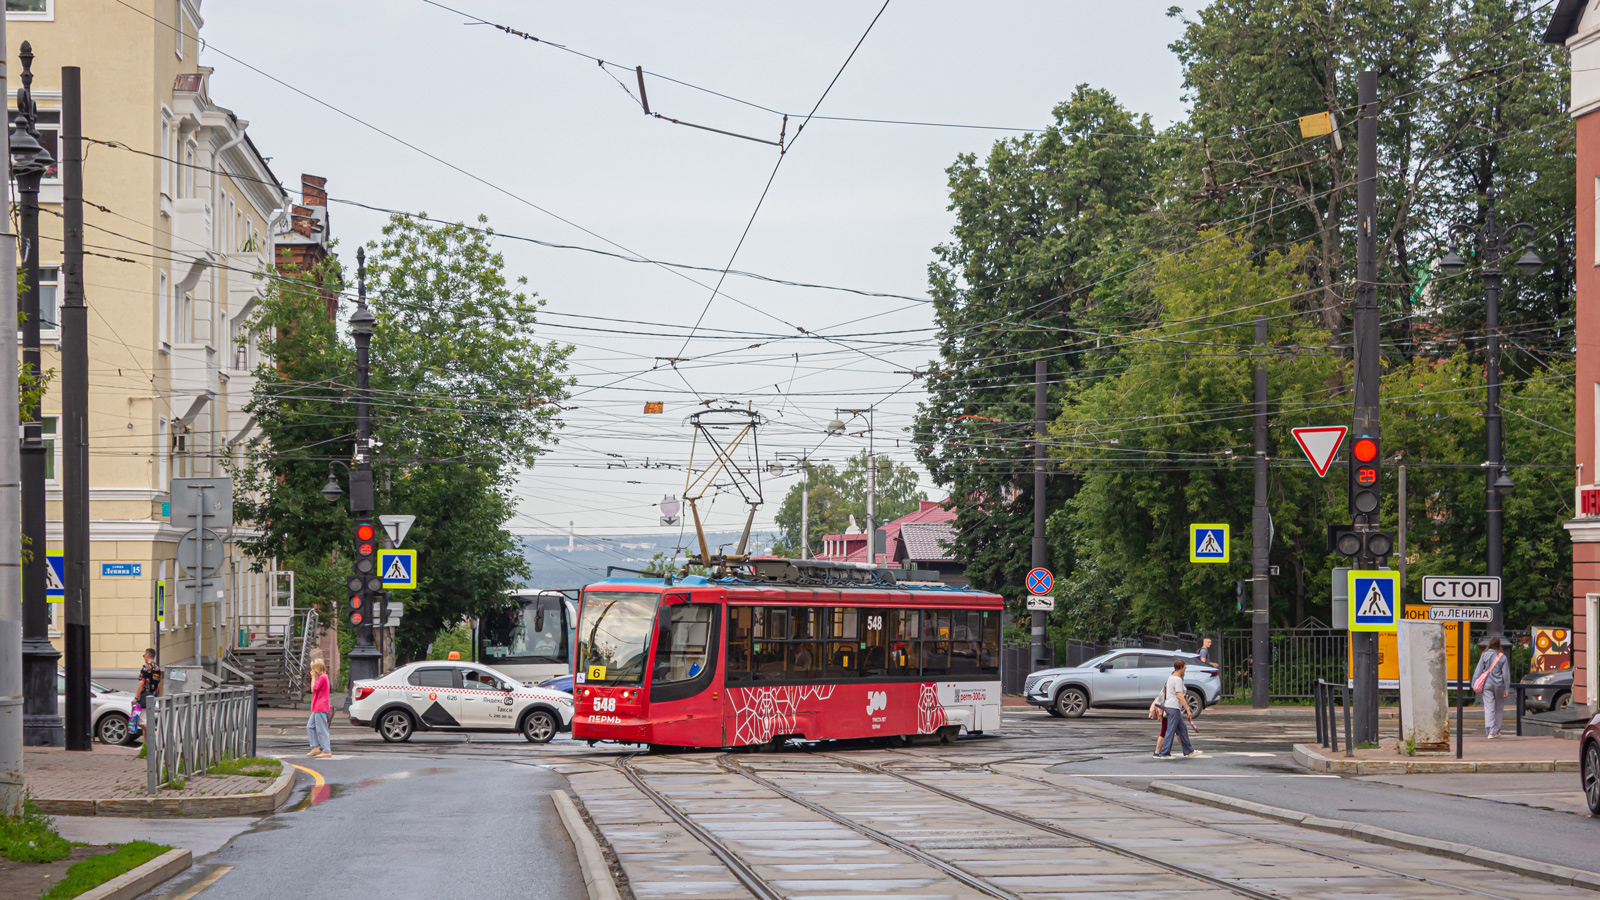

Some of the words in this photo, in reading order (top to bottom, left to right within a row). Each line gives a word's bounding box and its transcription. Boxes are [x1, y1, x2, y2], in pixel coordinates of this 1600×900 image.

[1359, 469, 1376, 483] 29
[104, 567, 130, 575] Ленина
[132, 566, 140, 574] 15
[1432, 581, 1491, 598] СТОП
[868, 616, 882, 630] 548
[593, 668, 601, 678] 6
[593, 697, 616, 712] 548
[588, 715, 621, 724] ПЕРМЬ
